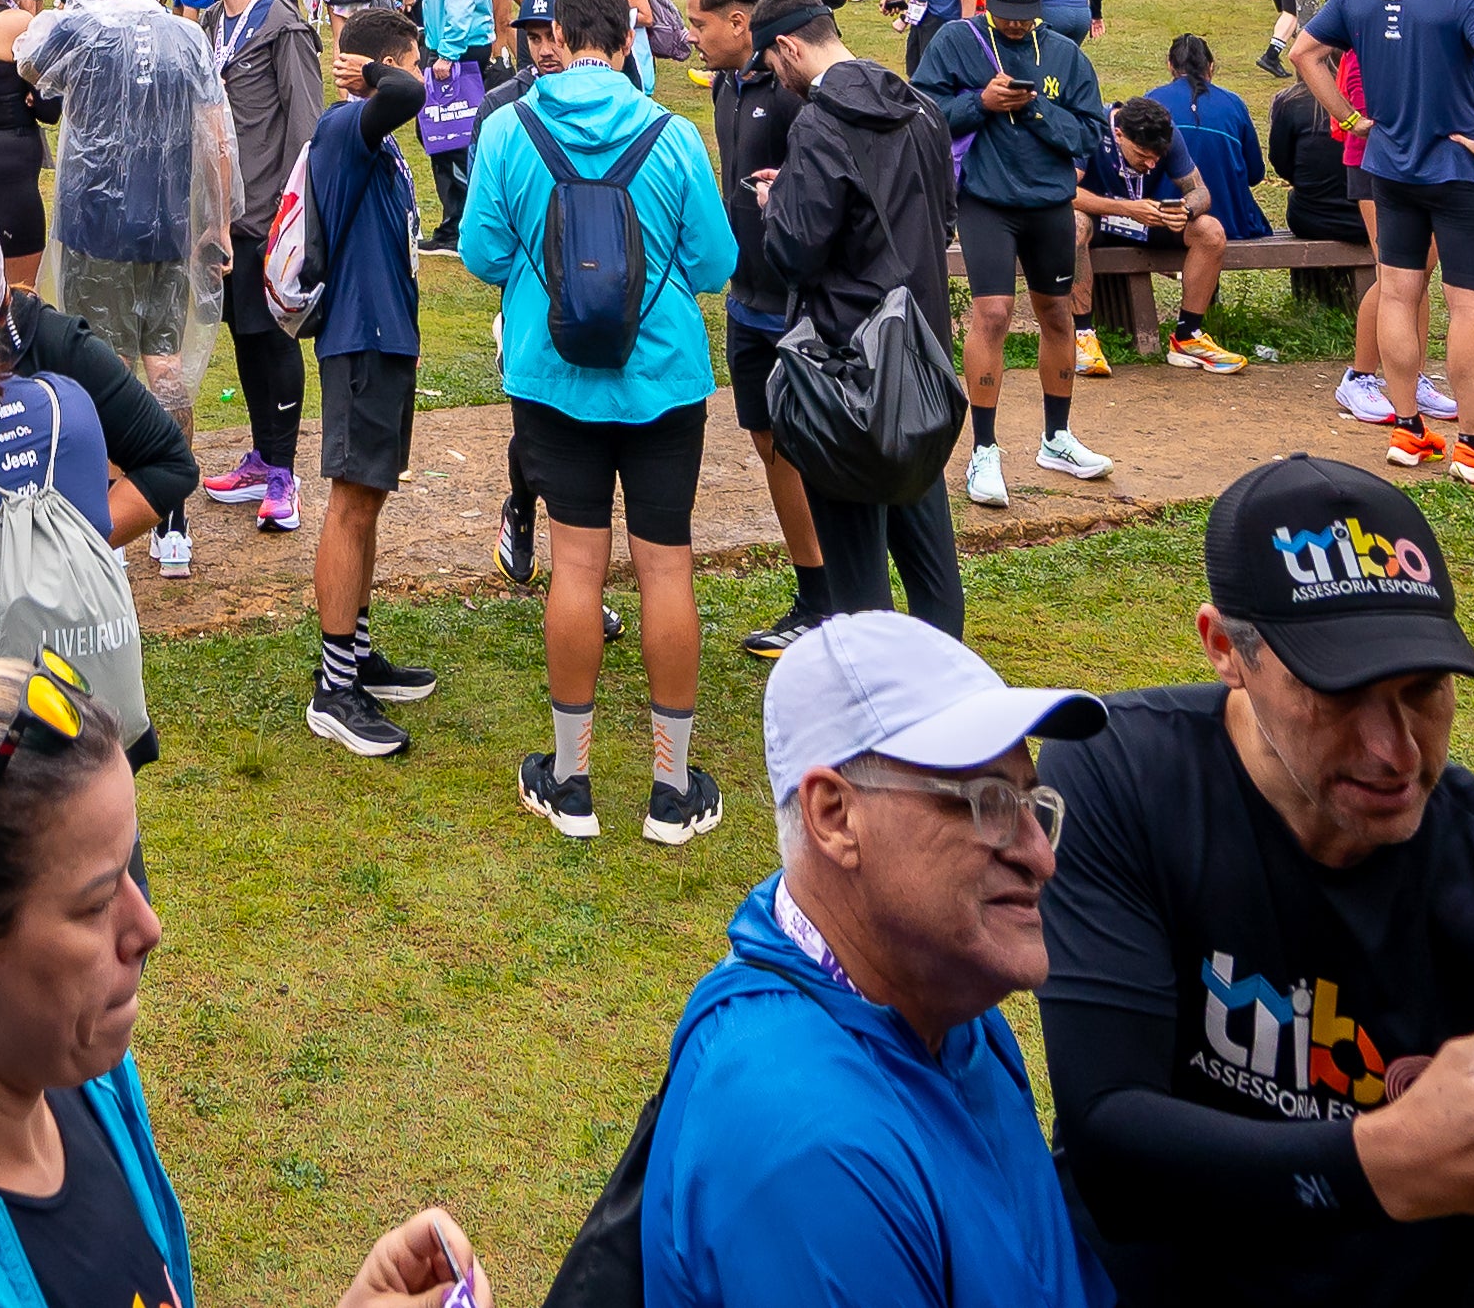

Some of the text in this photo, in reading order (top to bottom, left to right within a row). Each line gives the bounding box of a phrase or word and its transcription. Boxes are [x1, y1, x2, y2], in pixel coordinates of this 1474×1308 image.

[1, 449, 39, 472] Jeep
[1292, 576, 1441, 604] ASSESSORIA ESPORTIVA
[1190, 1048, 1321, 1122] ASSESSORIA
